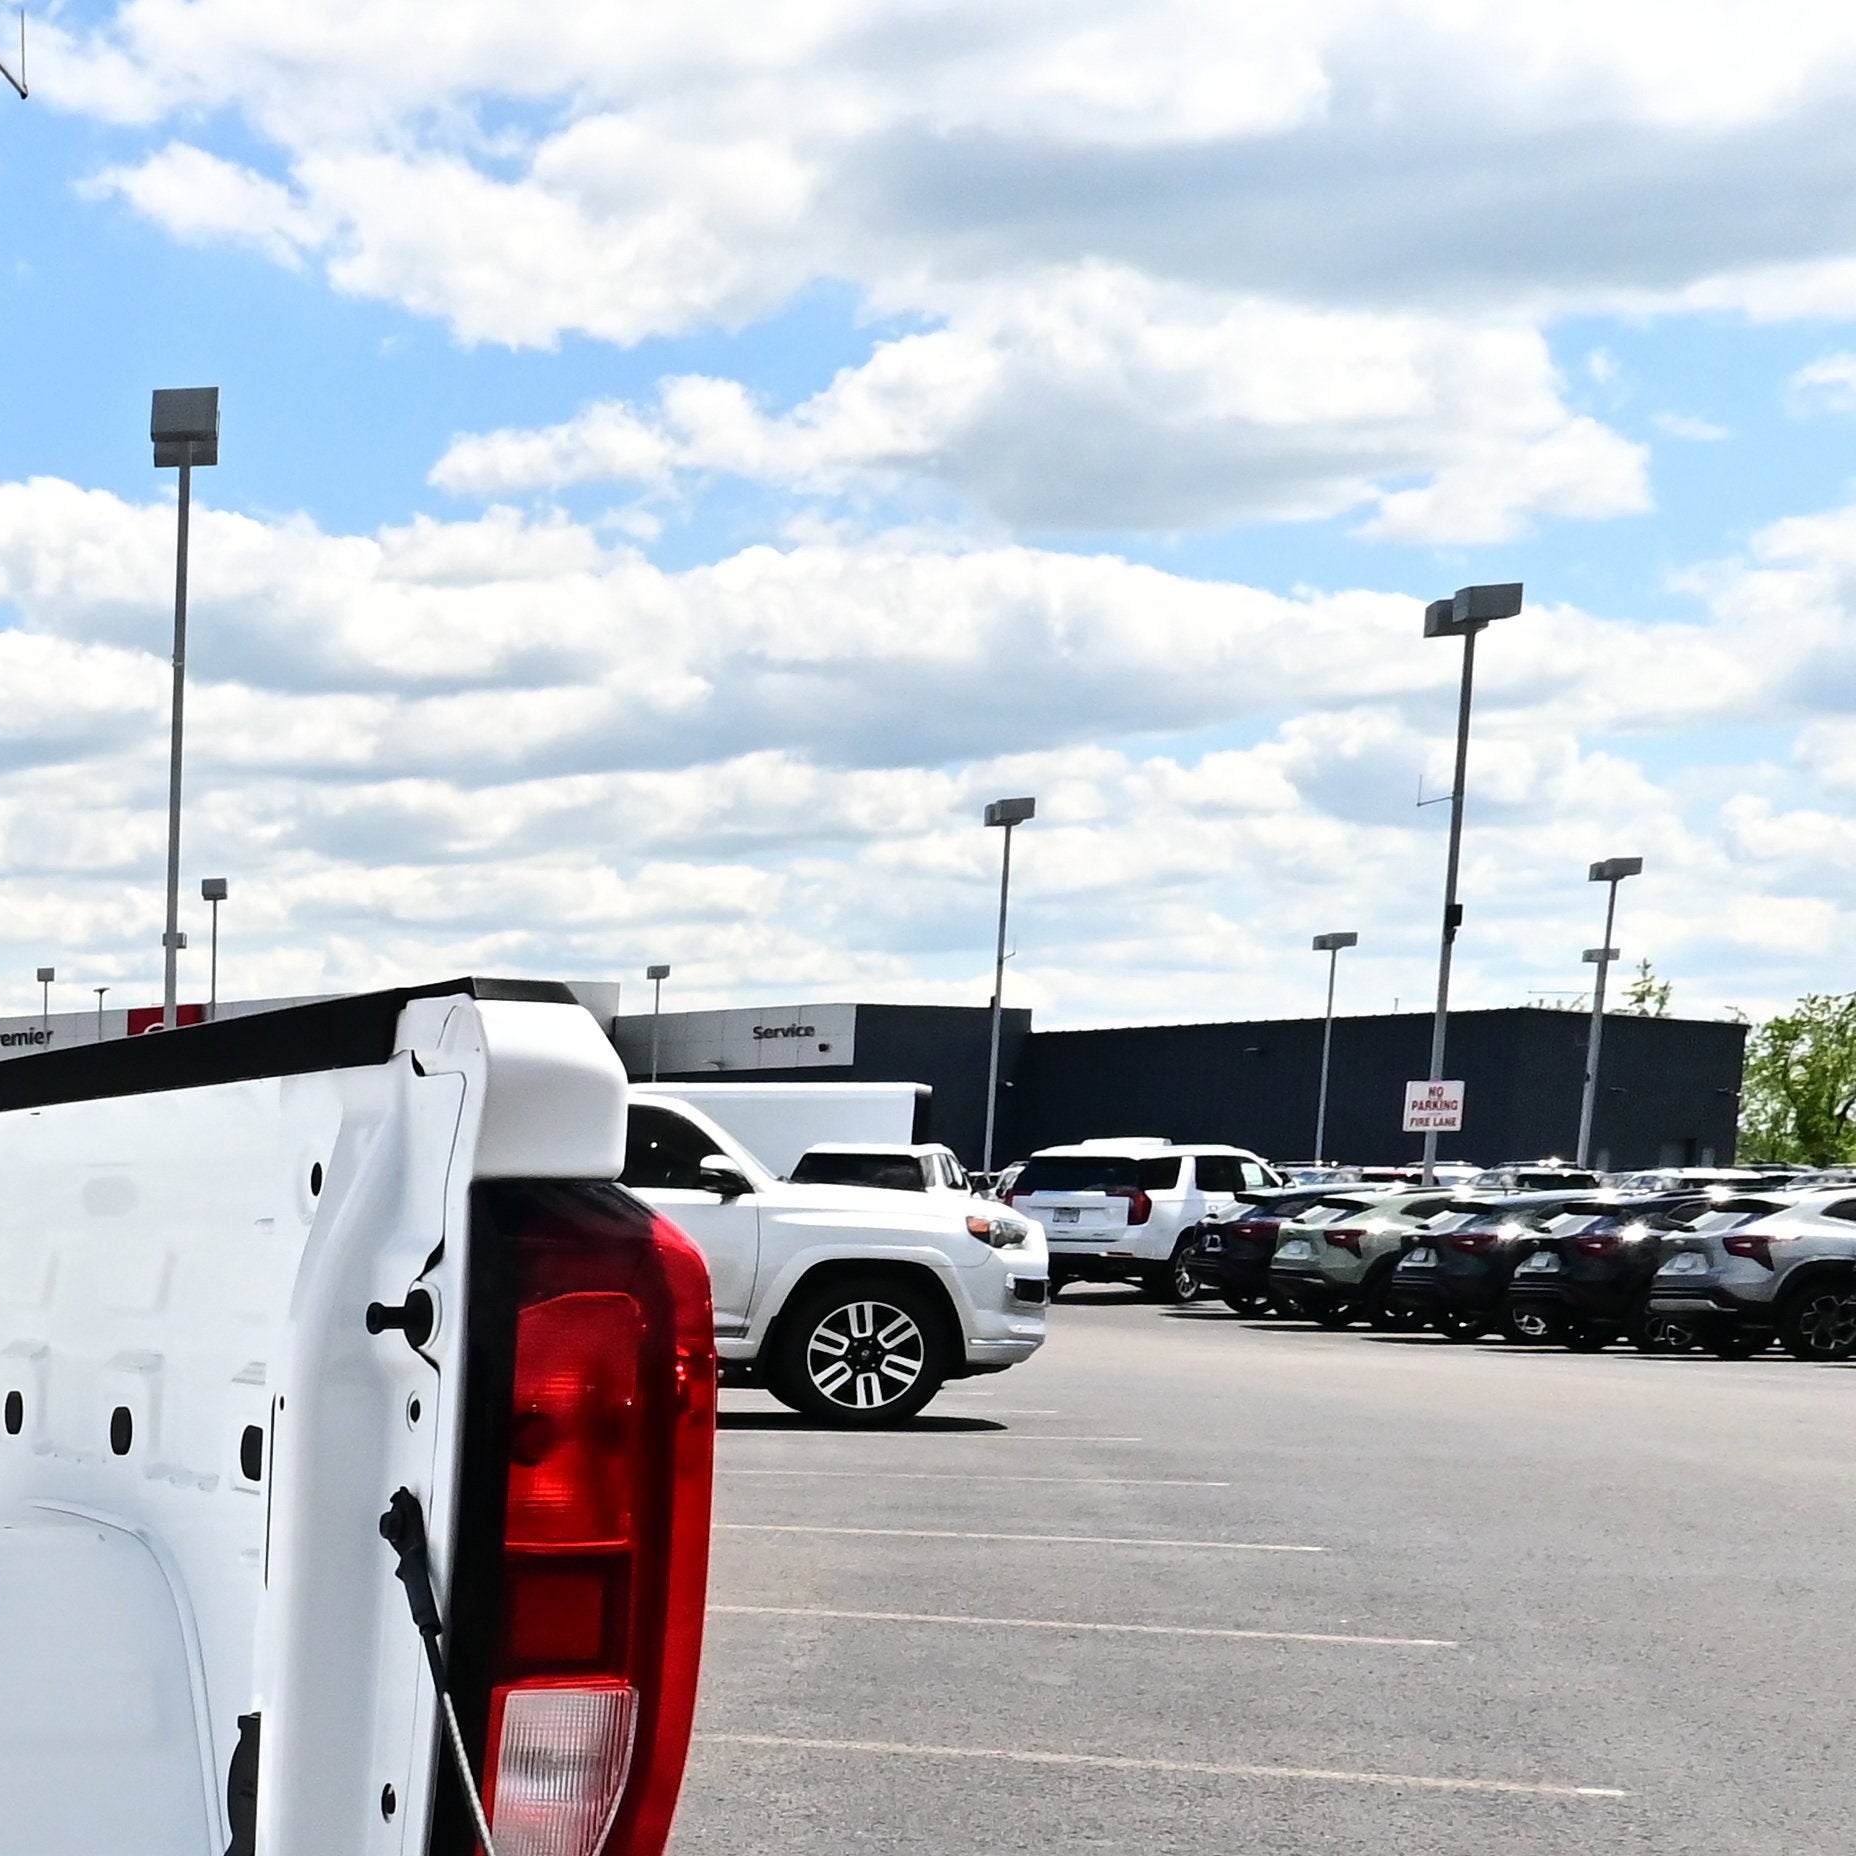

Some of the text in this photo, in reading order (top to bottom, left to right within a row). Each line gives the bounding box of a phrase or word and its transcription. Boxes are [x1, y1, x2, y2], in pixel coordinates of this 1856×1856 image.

[752, 1023, 815, 1040] Service
[1428, 1086, 1444, 1097] NO
[1411, 1100, 1458, 1111] PARKING
[1409, 1117, 1457, 1127] FIRE LANE
